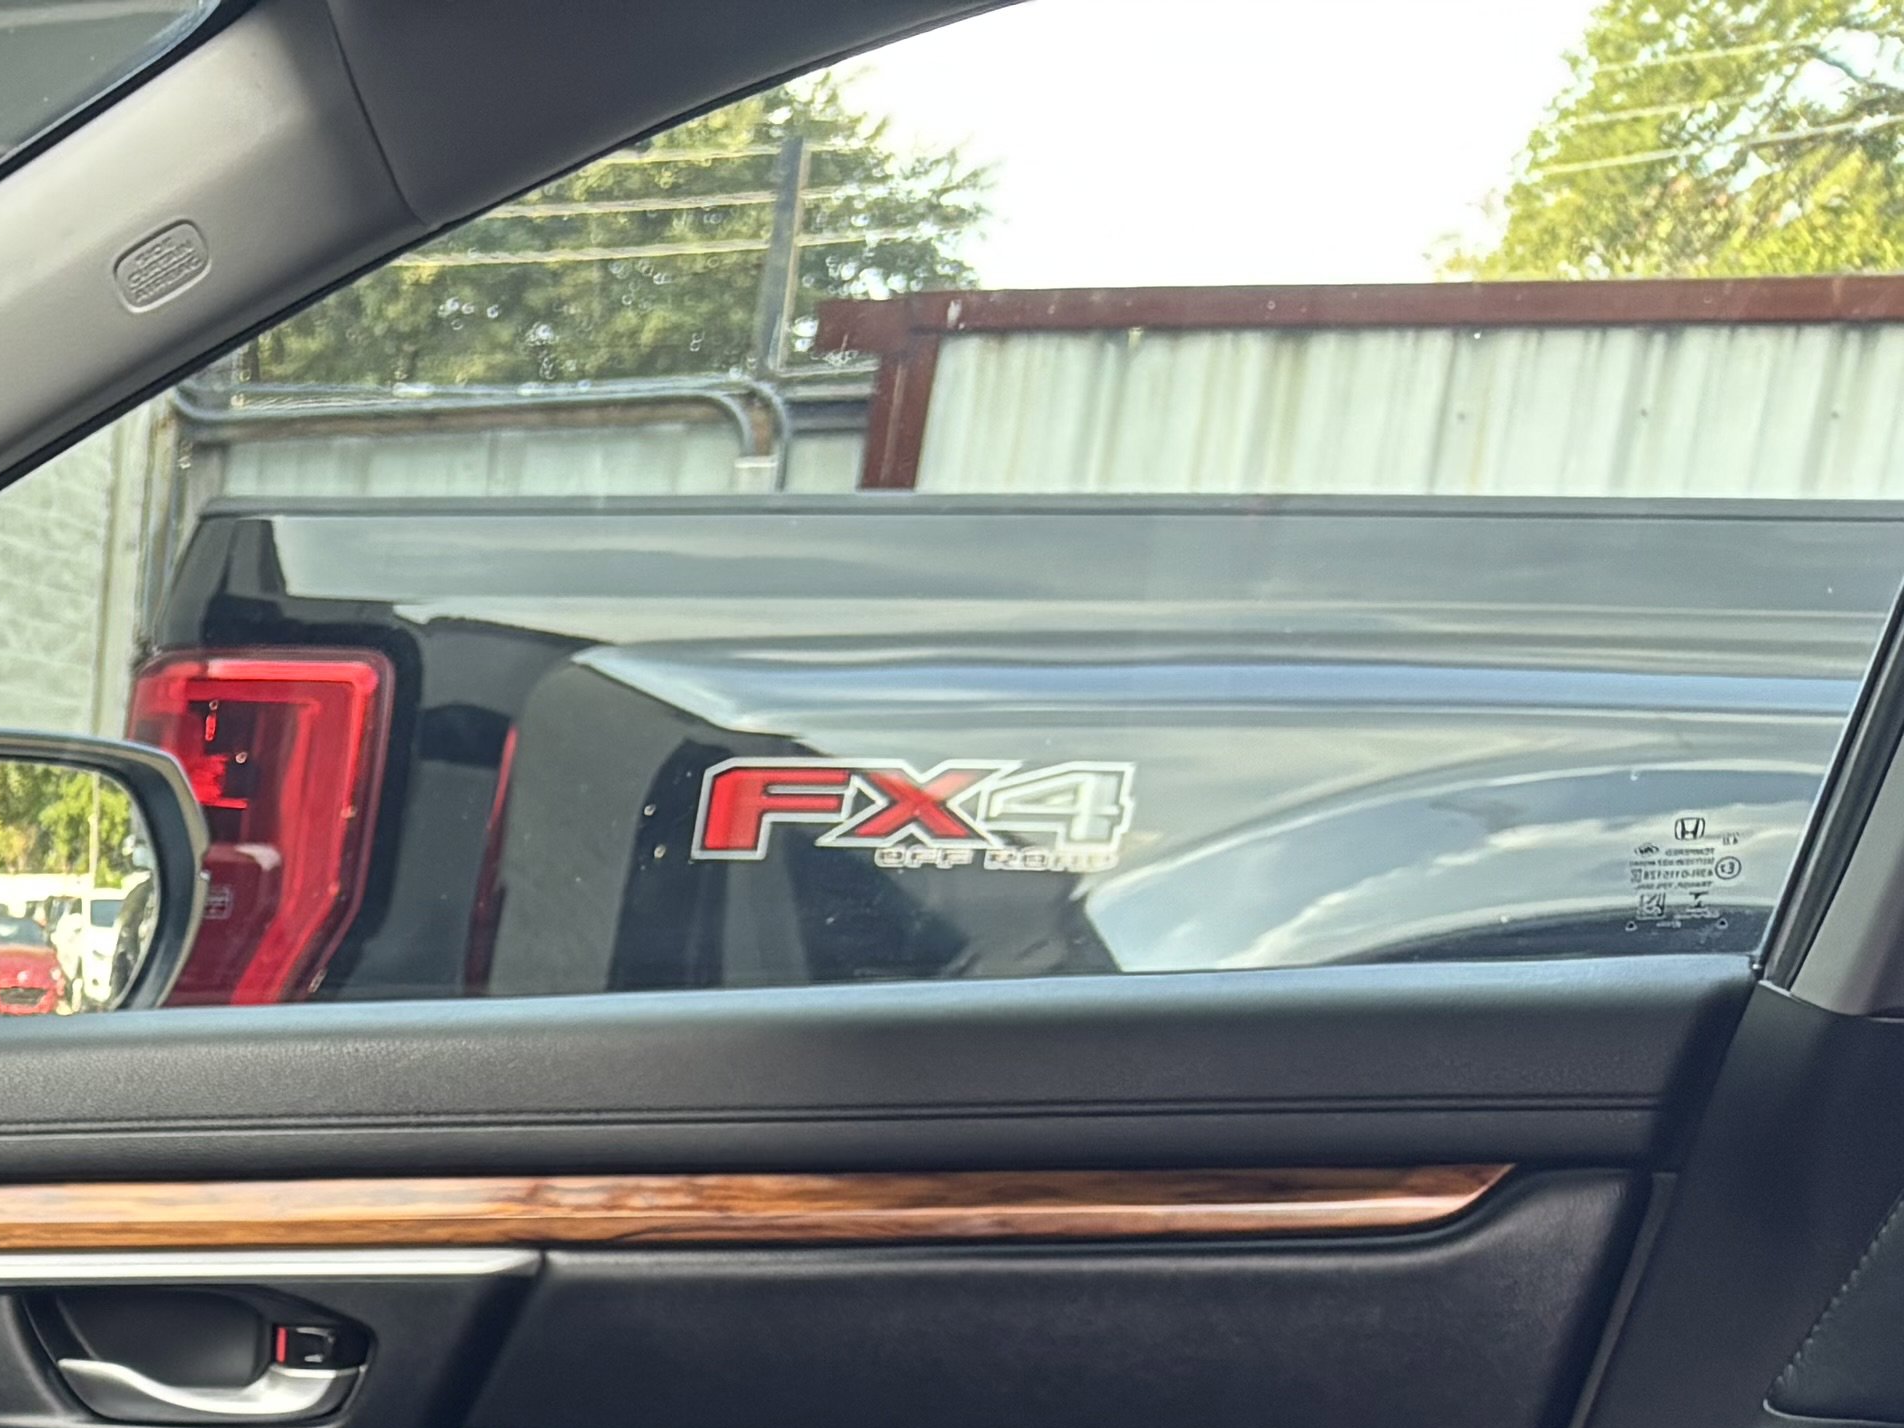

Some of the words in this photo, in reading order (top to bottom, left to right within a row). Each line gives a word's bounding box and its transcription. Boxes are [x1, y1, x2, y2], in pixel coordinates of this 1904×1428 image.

[691, 757, 1135, 861] FX4
[874, 847, 973, 869] OFF
[984, 845, 1119, 872] ROAD
